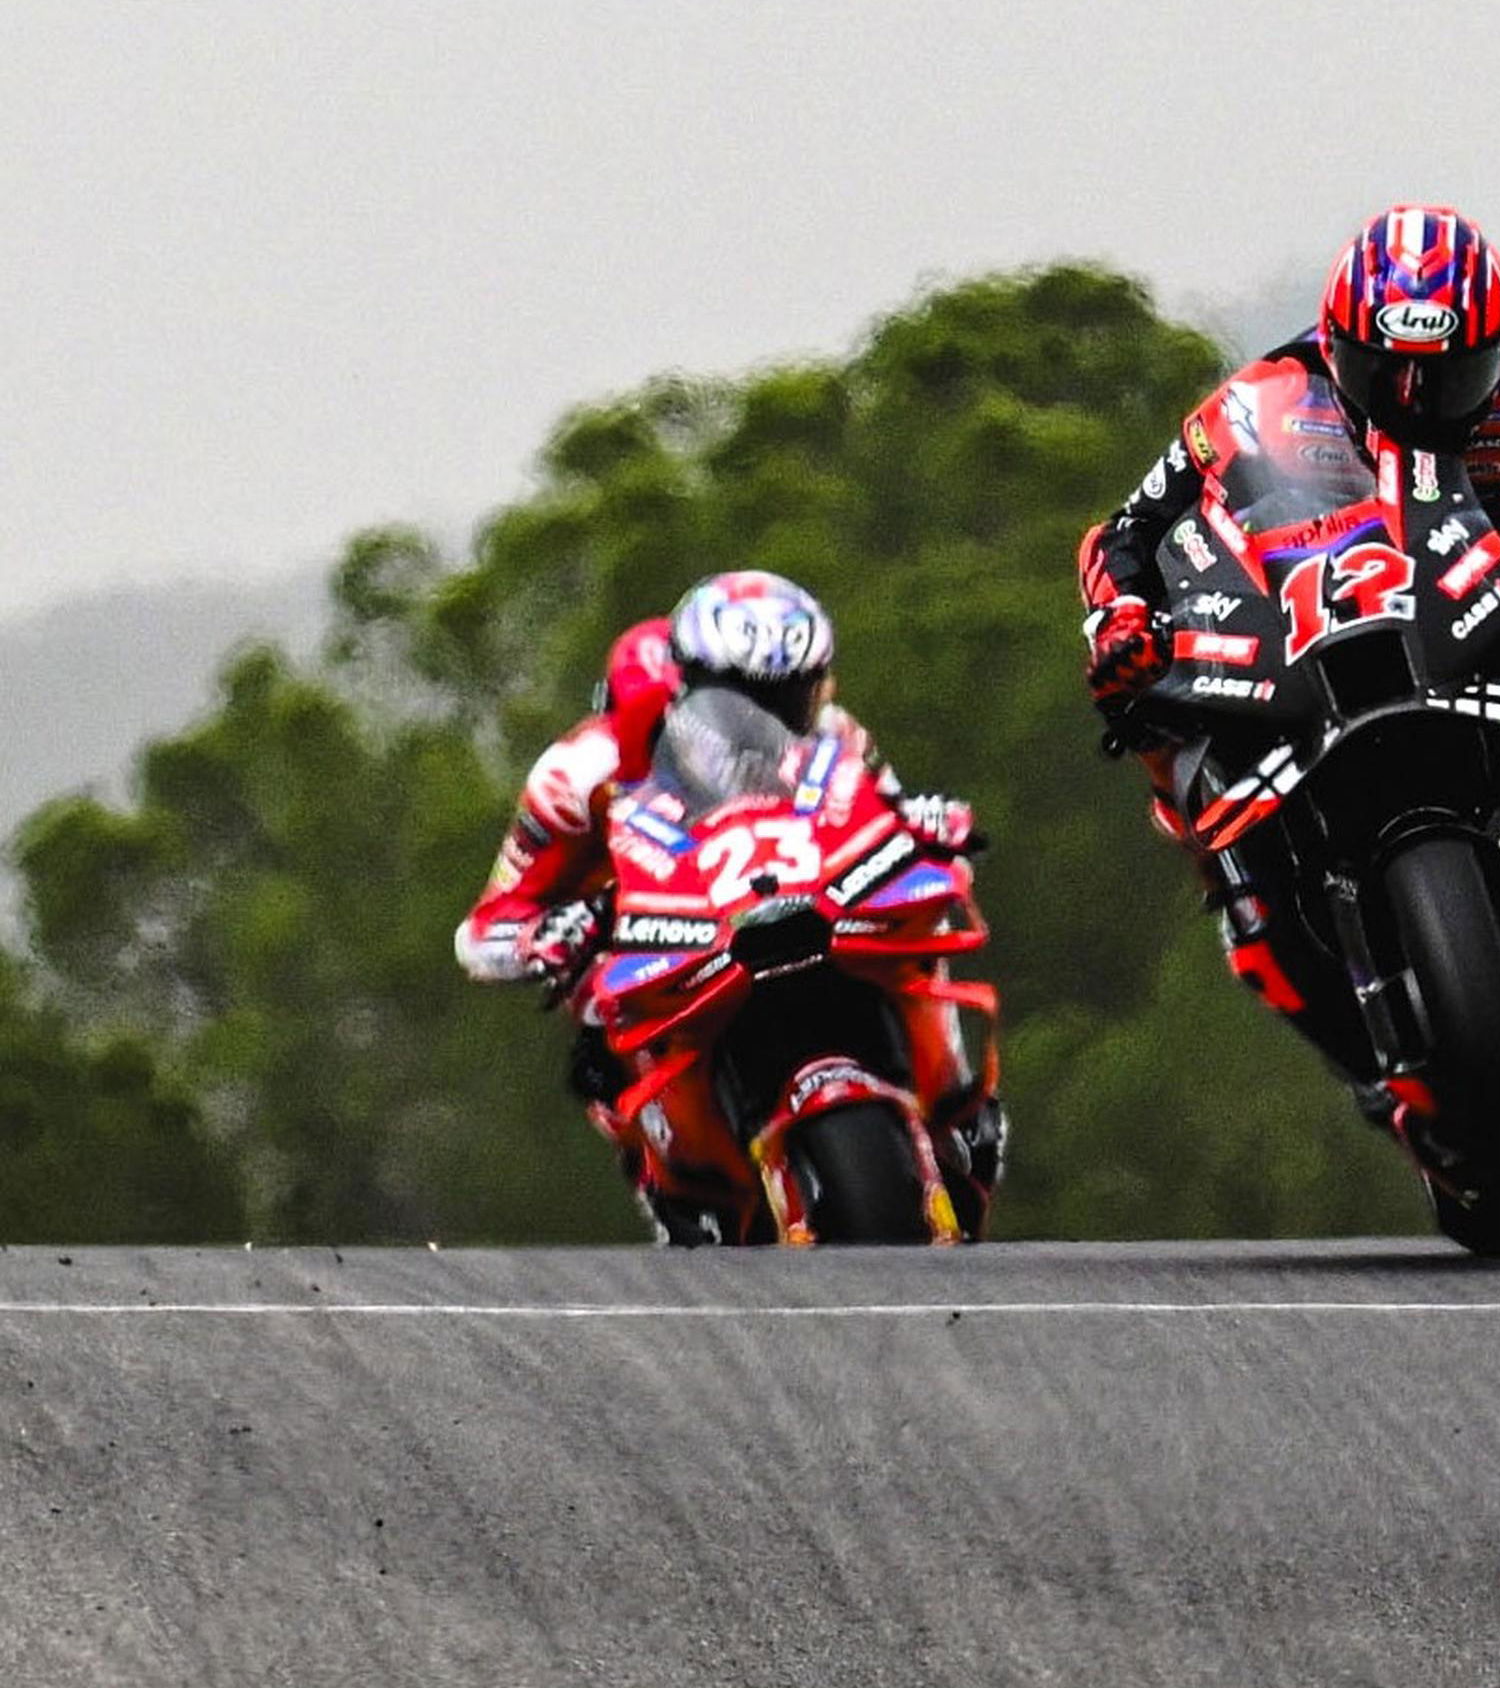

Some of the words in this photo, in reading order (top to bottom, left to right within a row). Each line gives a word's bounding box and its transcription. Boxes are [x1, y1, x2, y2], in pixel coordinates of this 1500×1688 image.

[1389, 305, 1448, 333] Arai
[1192, 591, 1242, 621] sky
[1280, 543, 1416, 667] 12
[1451, 592, 1499, 640] CASE
[1192, 675, 1254, 697] CASE
[698, 819, 821, 908] 23
[617, 915, 717, 945] Lenovo
